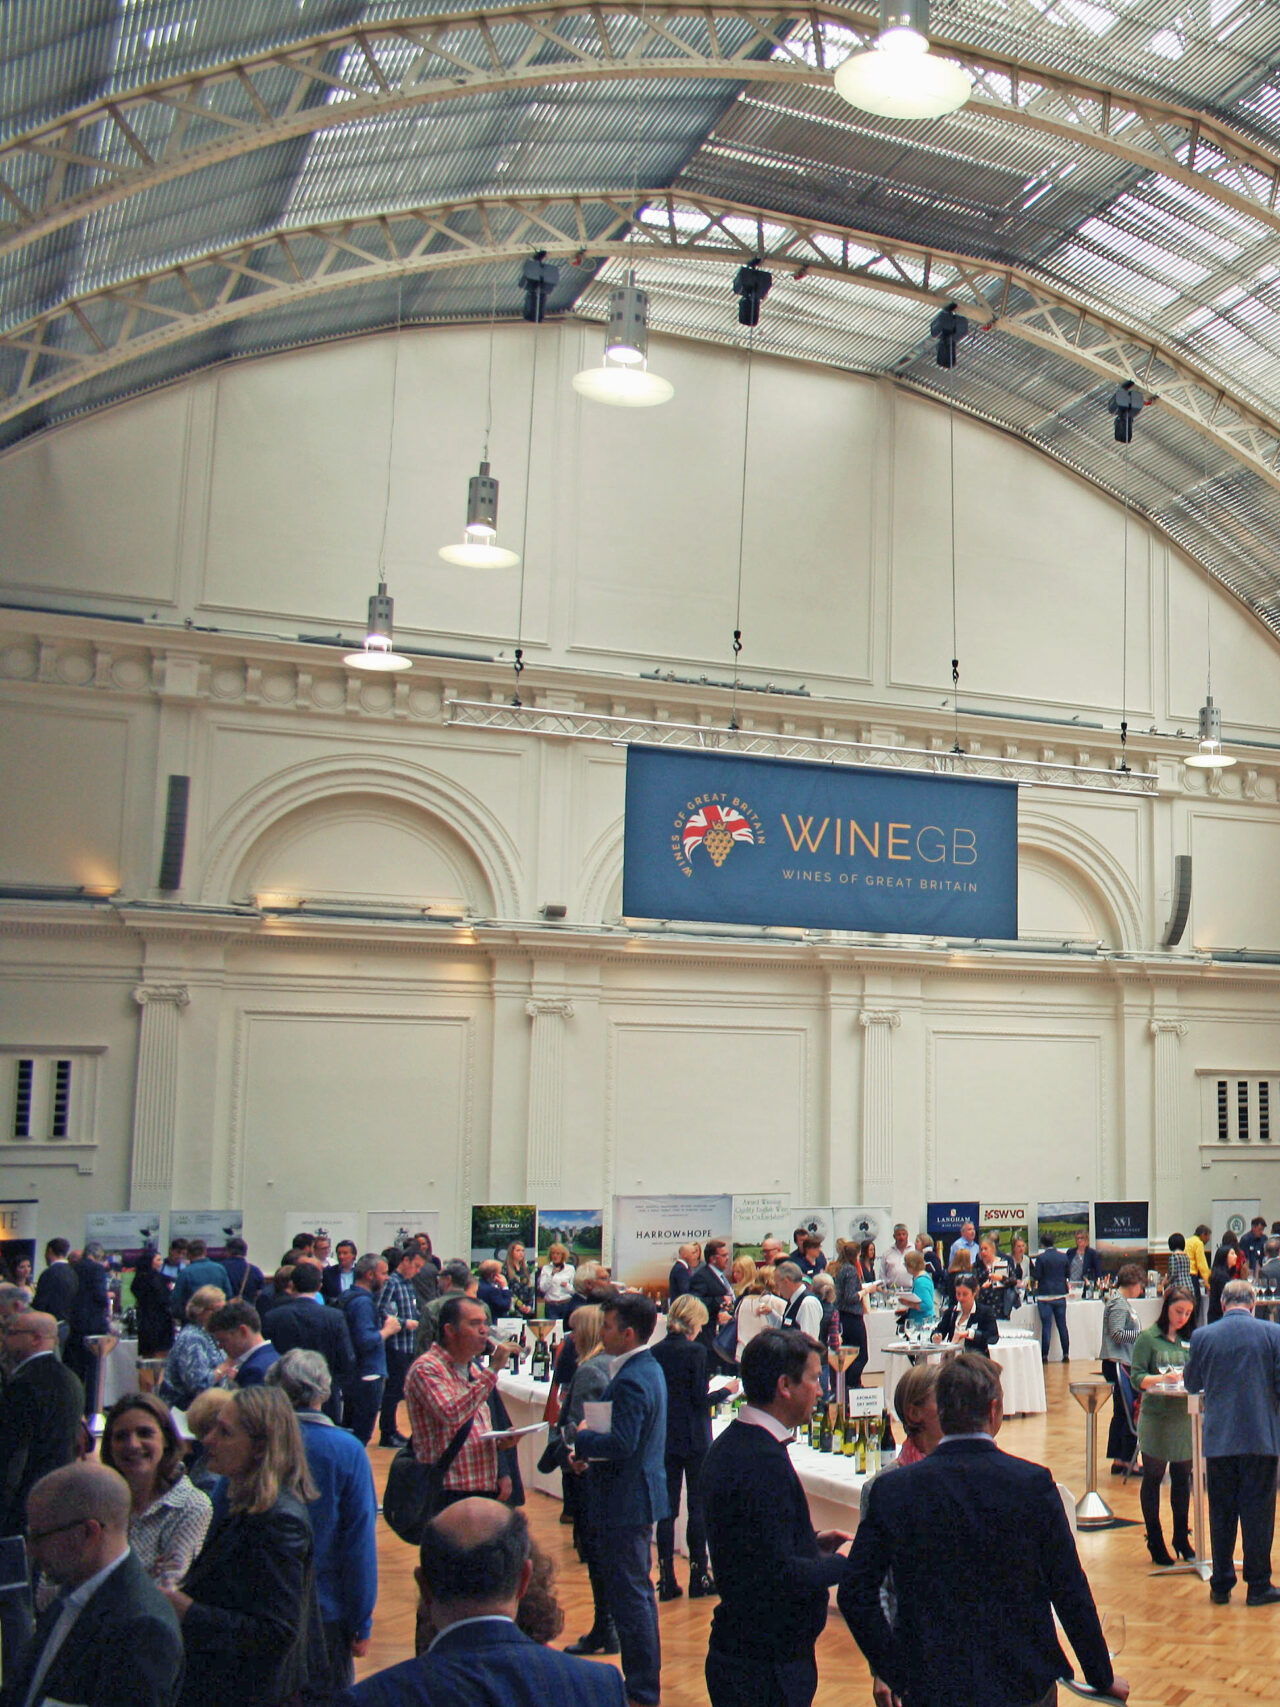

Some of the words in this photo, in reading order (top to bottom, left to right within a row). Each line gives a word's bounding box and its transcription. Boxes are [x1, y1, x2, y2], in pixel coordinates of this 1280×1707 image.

[687, 793, 727, 811] GREAT
[674, 811, 686, 828] OF
[732, 797, 766, 845] BRITAIN
[671, 835, 693, 877] WINES
[782, 869, 832, 883] WINES
[839, 873, 859, 885] OF
[865, 875, 913, 889] GREAT
[920, 878, 977, 893] BRITAIN
[635, 1230, 681, 1239] HARROW
[687, 1229, 712, 1238] HOPE
